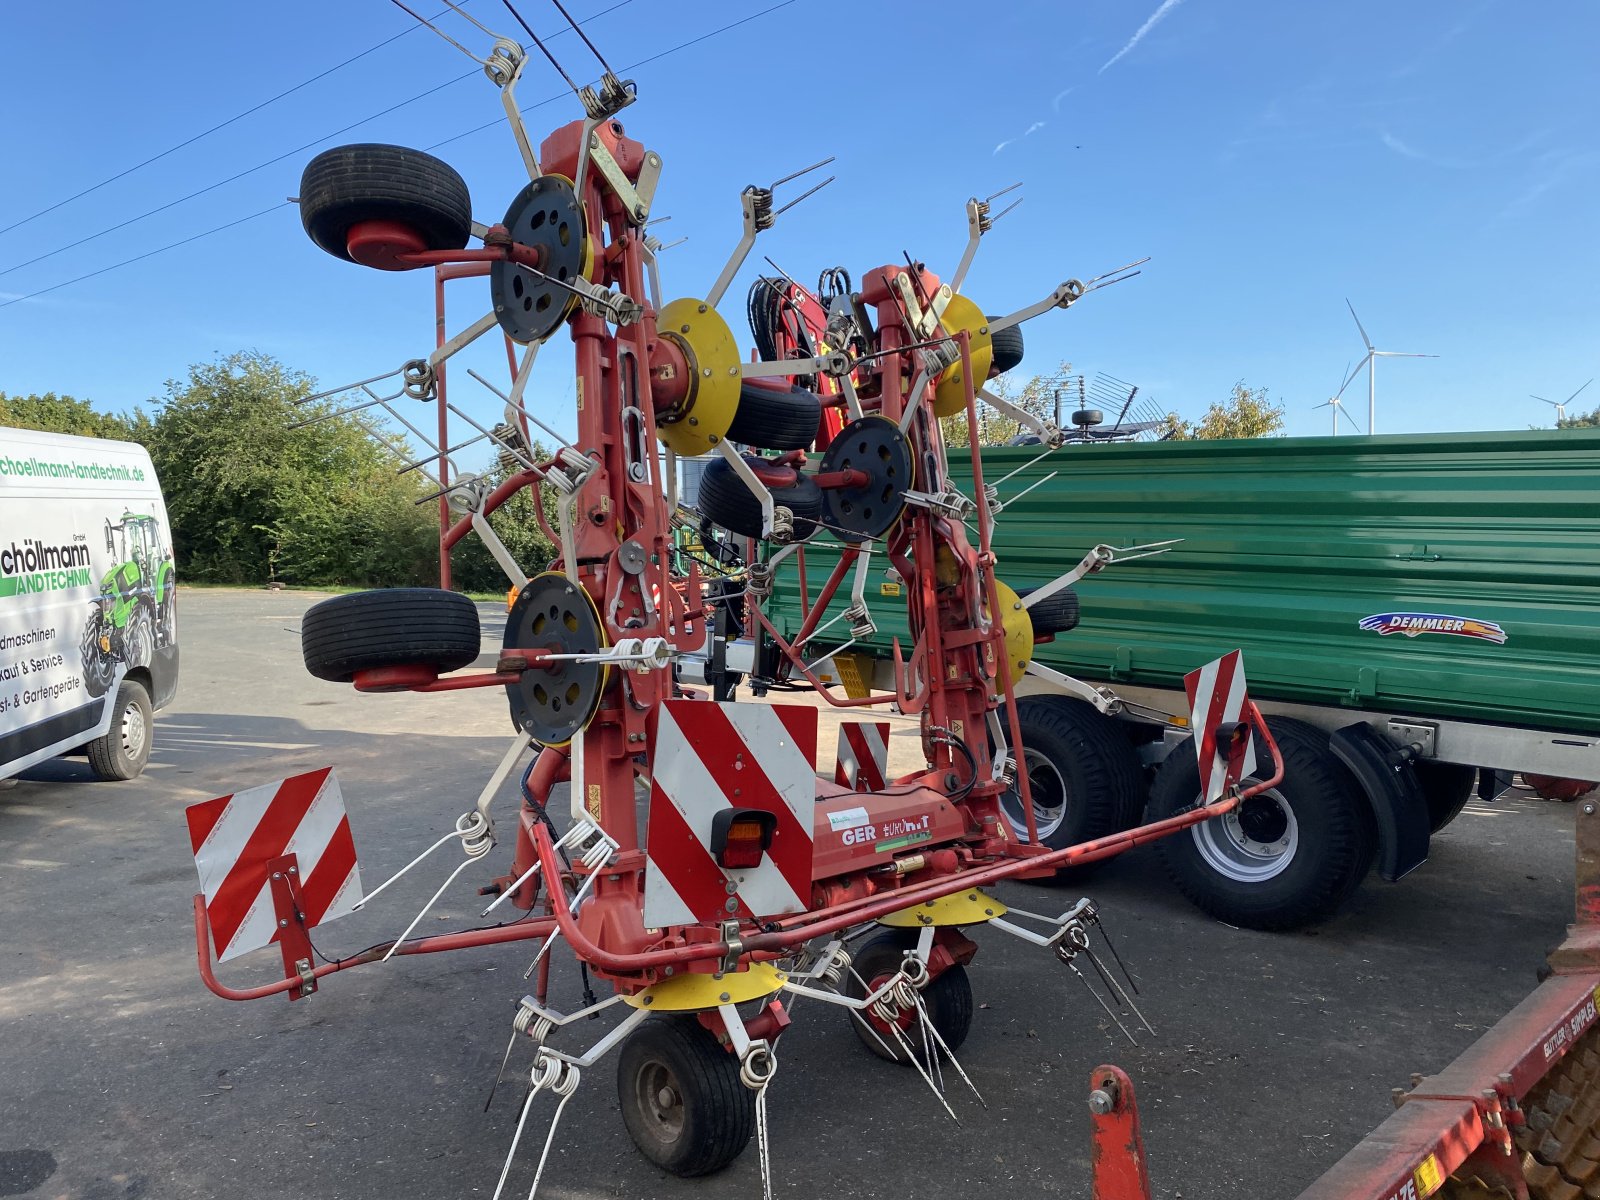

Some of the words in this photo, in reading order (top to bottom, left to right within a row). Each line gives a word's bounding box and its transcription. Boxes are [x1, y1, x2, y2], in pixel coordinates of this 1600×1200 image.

[1389, 616, 1465, 632] DEMMLER
[21, 661, 29, 675] &
[30, 654, 63, 672] Service
[13, 694, 20, 708] &
[23, 676, 80, 705] Gartengeräte
[842, 825, 877, 846] GER
